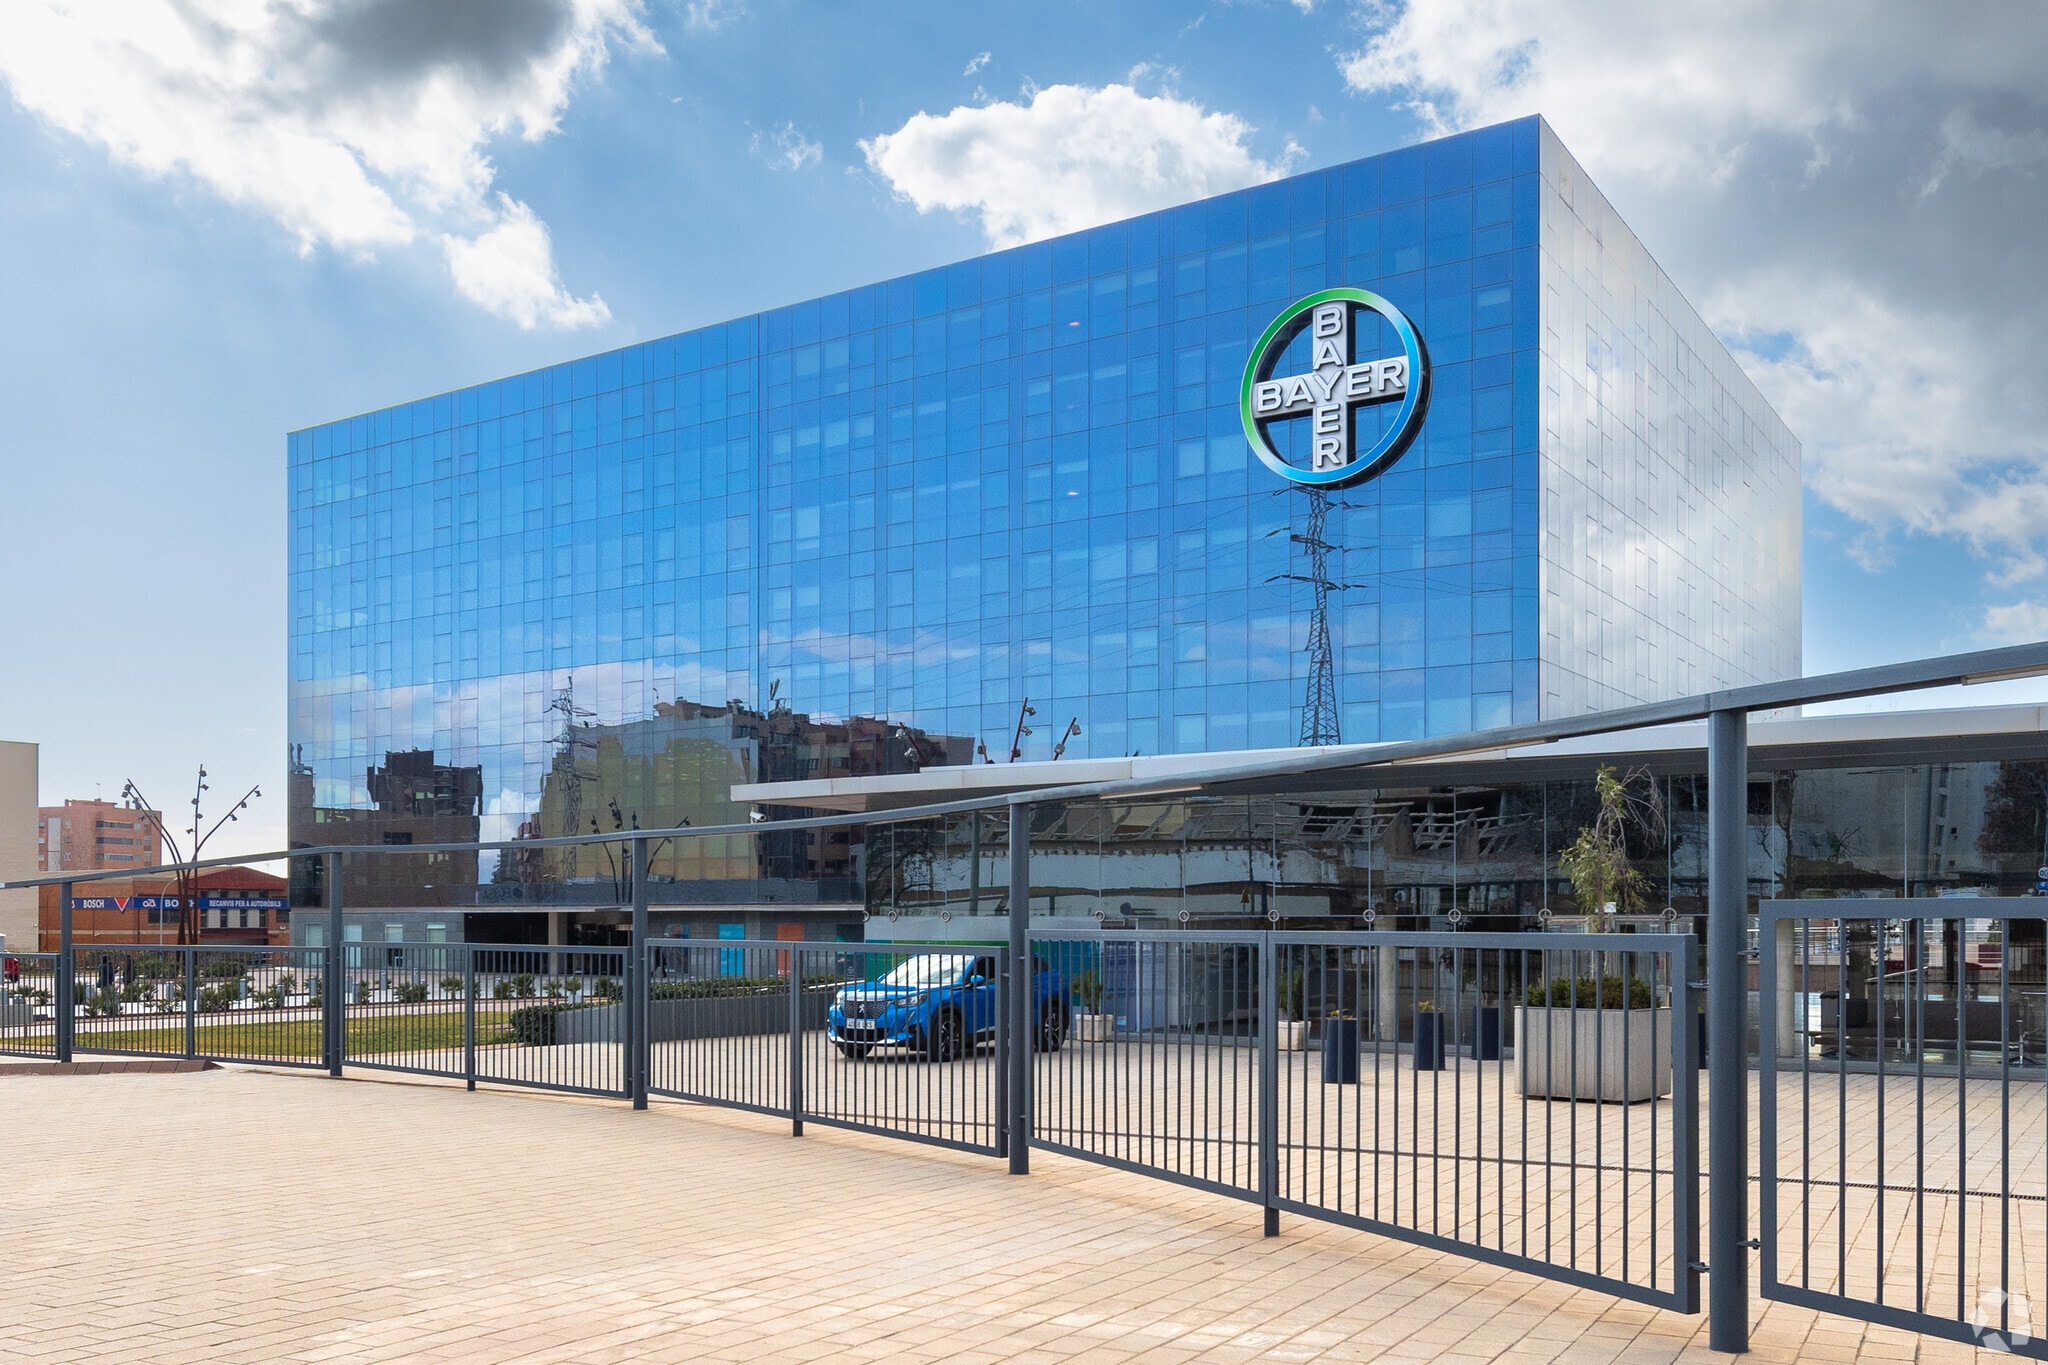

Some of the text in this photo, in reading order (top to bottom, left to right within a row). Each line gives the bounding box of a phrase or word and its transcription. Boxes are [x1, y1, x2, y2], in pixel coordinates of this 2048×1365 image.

[1257, 360, 1403, 412] BAYER
[1313, 306, 1344, 467] BAYER
[83, 899, 105, 908] BOSCH
[164, 899, 195, 907] BOH
